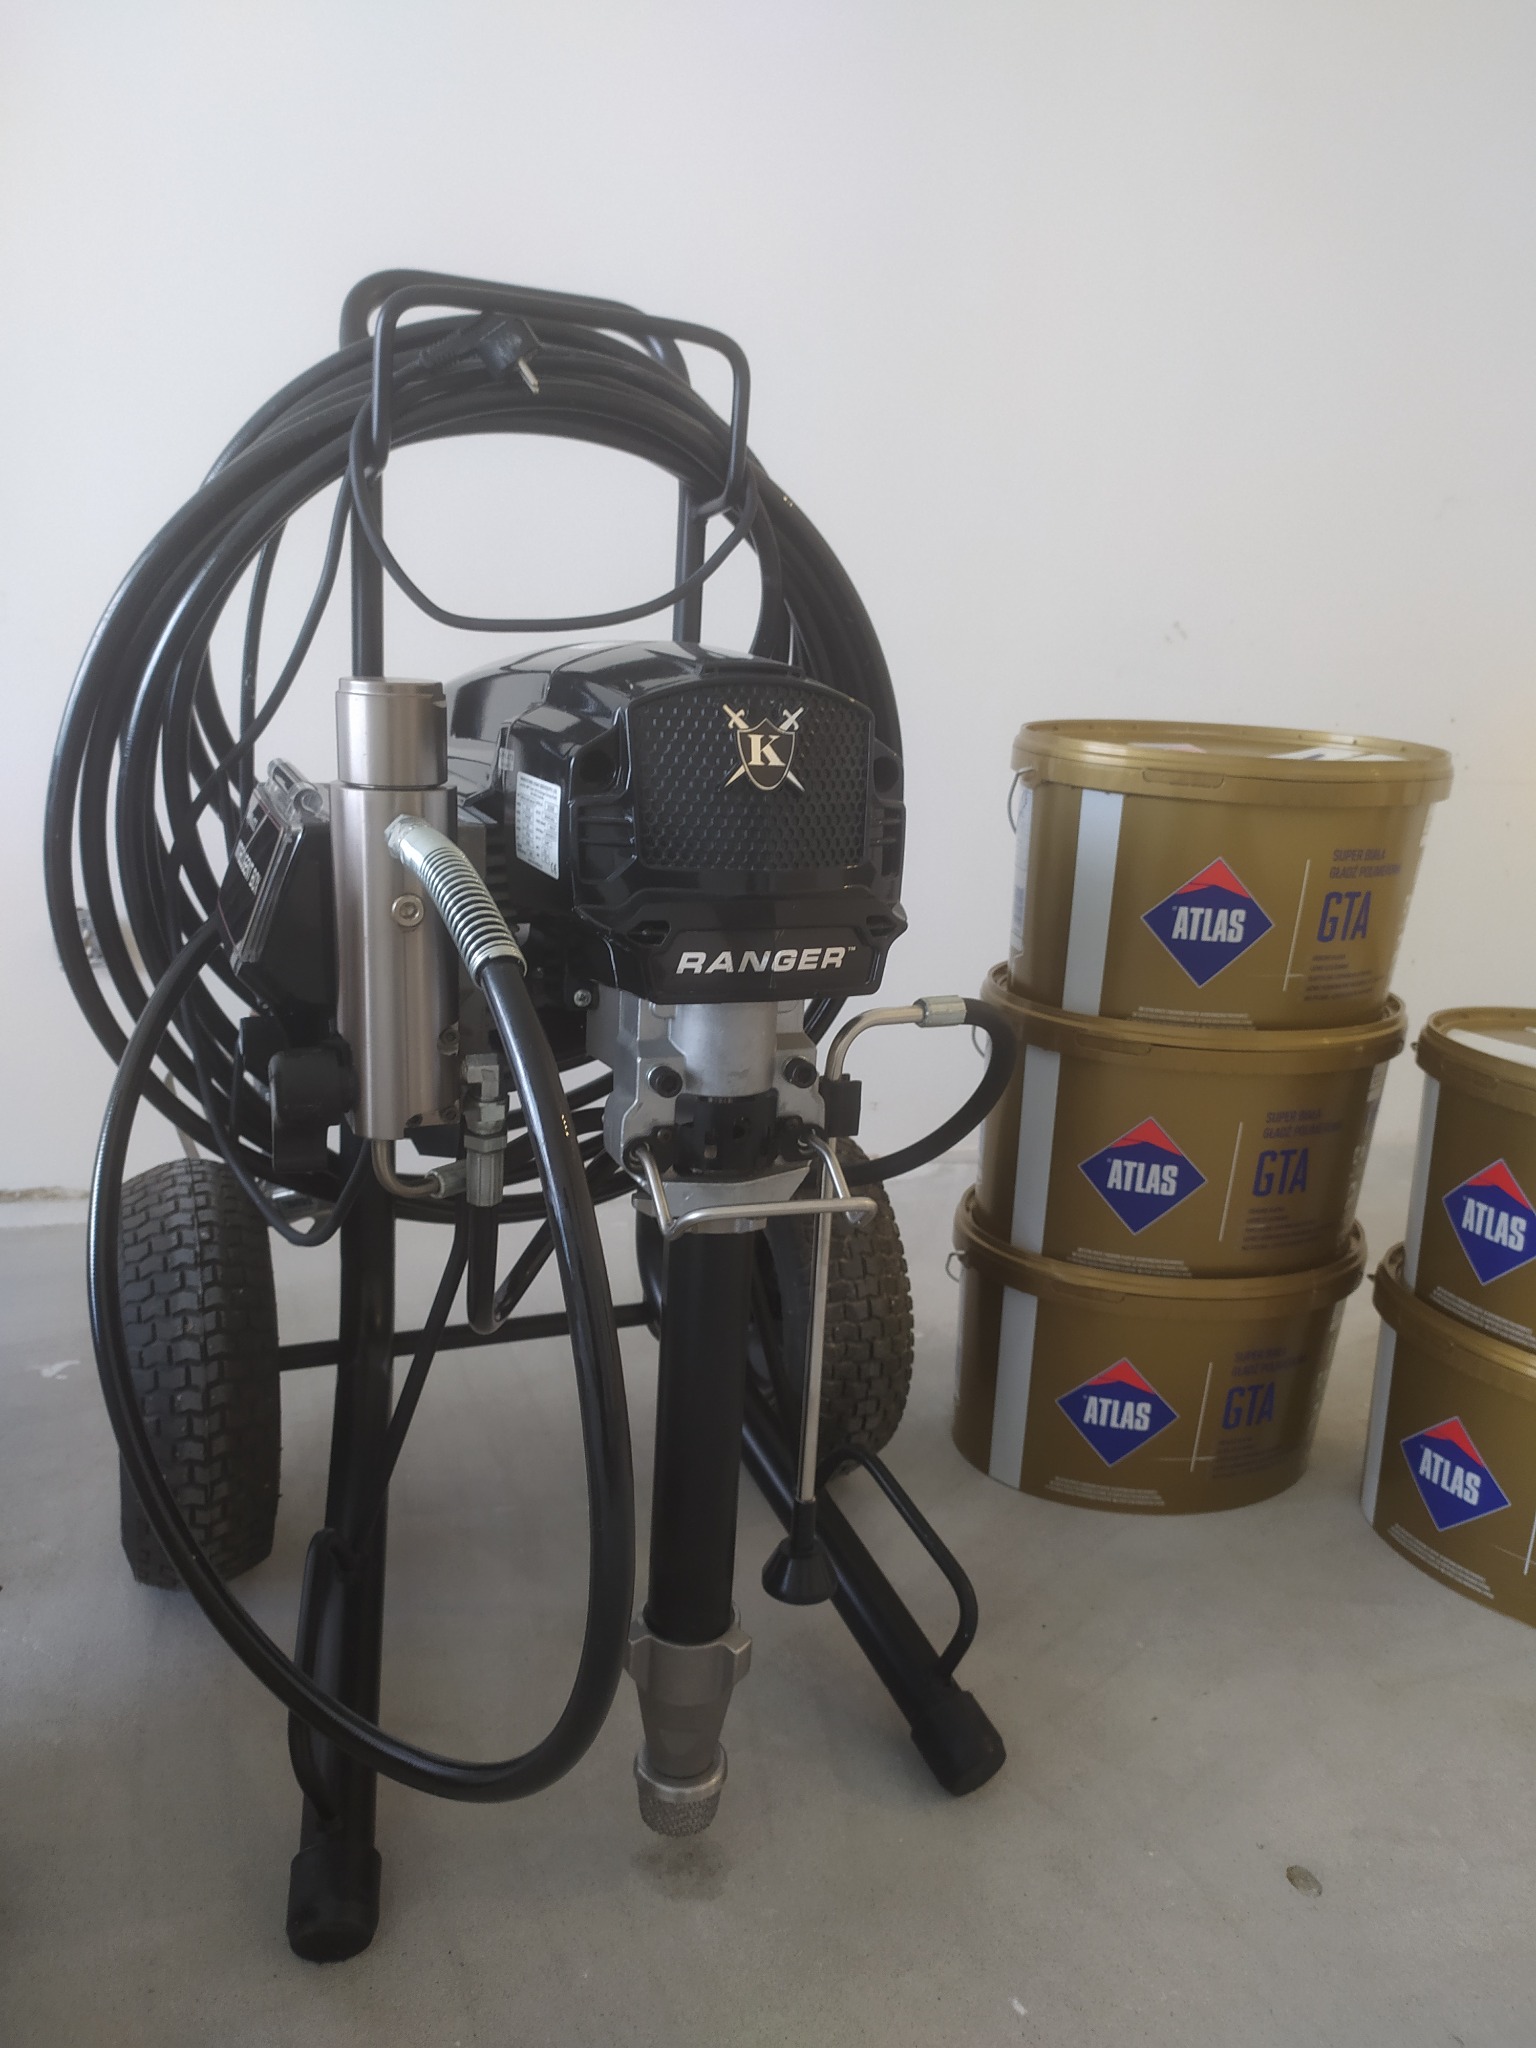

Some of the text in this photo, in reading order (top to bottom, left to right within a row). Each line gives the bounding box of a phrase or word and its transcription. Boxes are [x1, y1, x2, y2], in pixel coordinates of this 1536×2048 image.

[747, 733, 787, 767] K
[1333, 849, 1363, 861] SUPER
[1171, 906, 1247, 943] ATLAS
[1316, 890, 1372, 943] GTA
[1107, 1158, 1179, 1196] ATLAS
[1252, 1147, 1309, 1197] GTA
[1461, 1197, 1528, 1253] ATLAS
[1083, 1395, 1152, 1431] ATLAS
[1221, 1381, 1275, 1430] GTA
[1418, 1447, 1482, 1507] ATLAS
